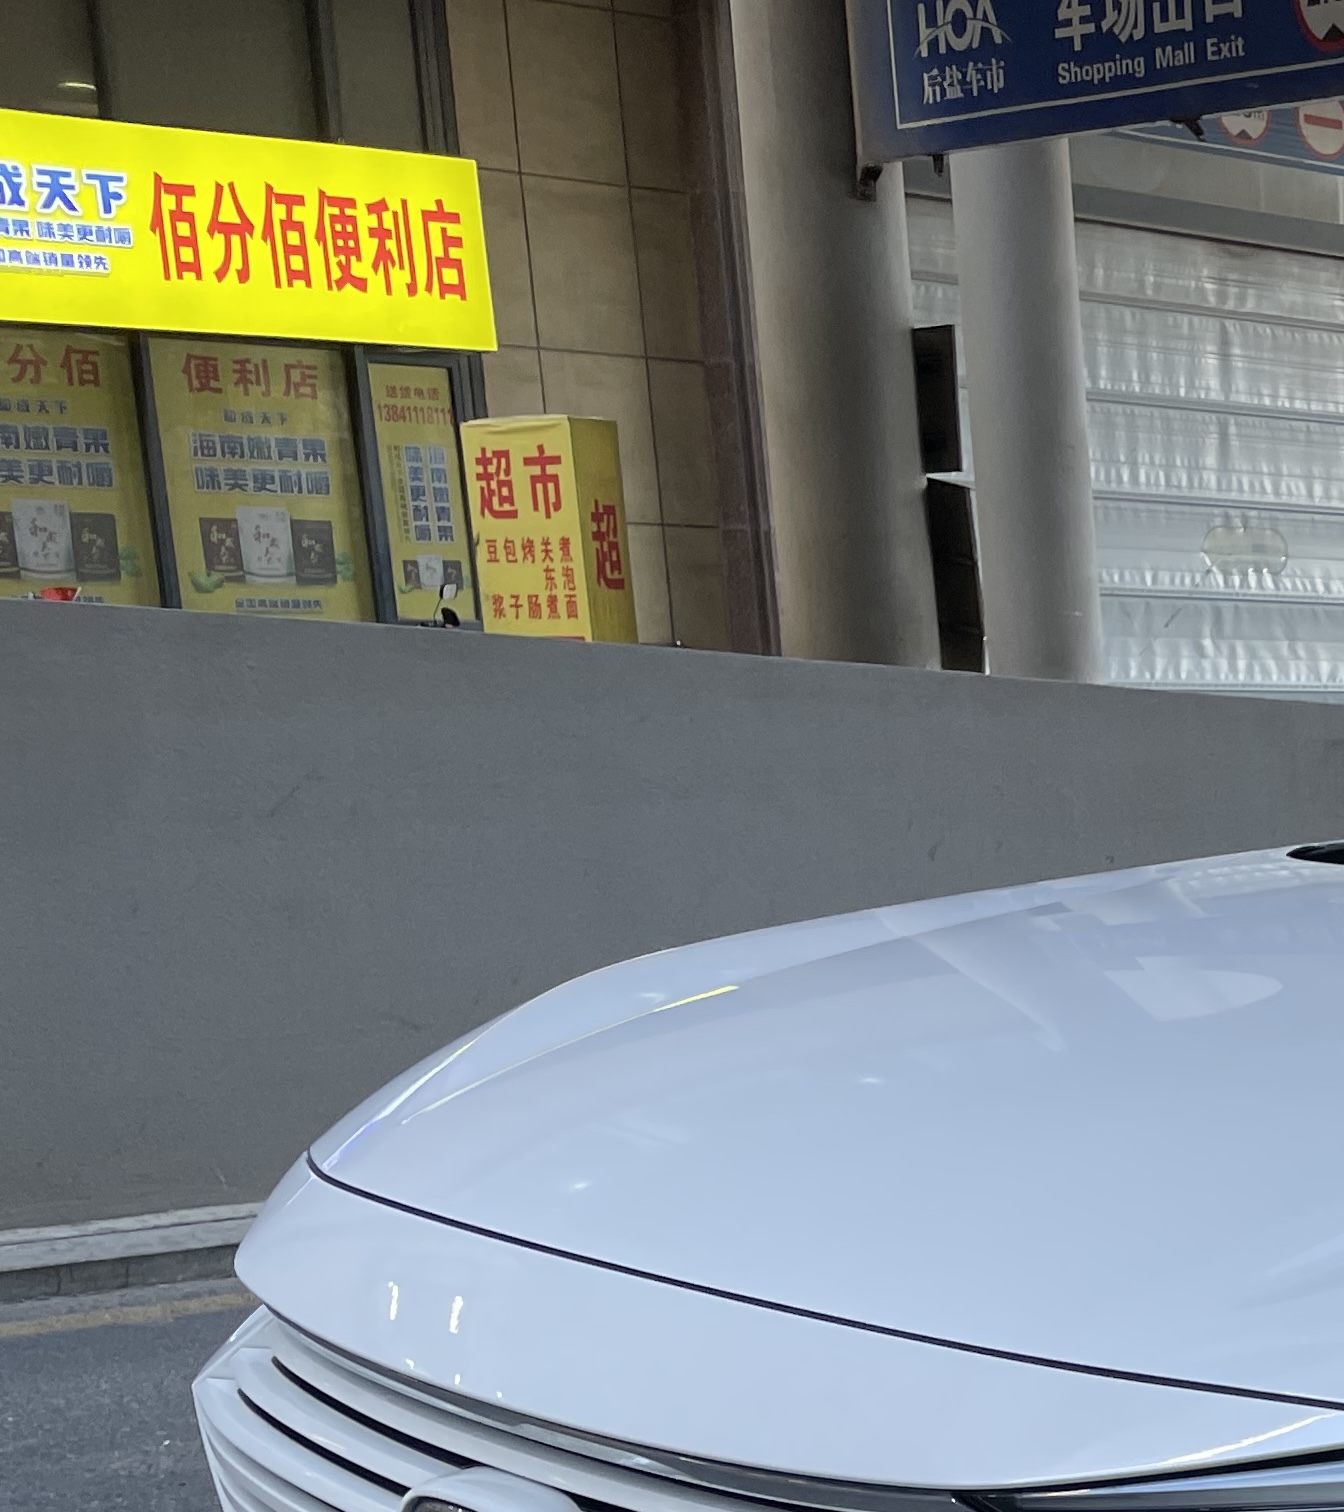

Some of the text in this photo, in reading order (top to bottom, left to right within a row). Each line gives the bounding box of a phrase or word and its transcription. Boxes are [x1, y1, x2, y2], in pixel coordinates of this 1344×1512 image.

[923, 58, 1005, 105] 后盐车市
[1057, 34, 1245, 85] Shopping Mall Exit
[150, 171, 468, 301] 佰分佰便利店
[7, 343, 101, 387] 分佰
[181, 352, 319, 400] 便利店
[475, 443, 562, 520] 超市
[590, 497, 625, 590] 超
